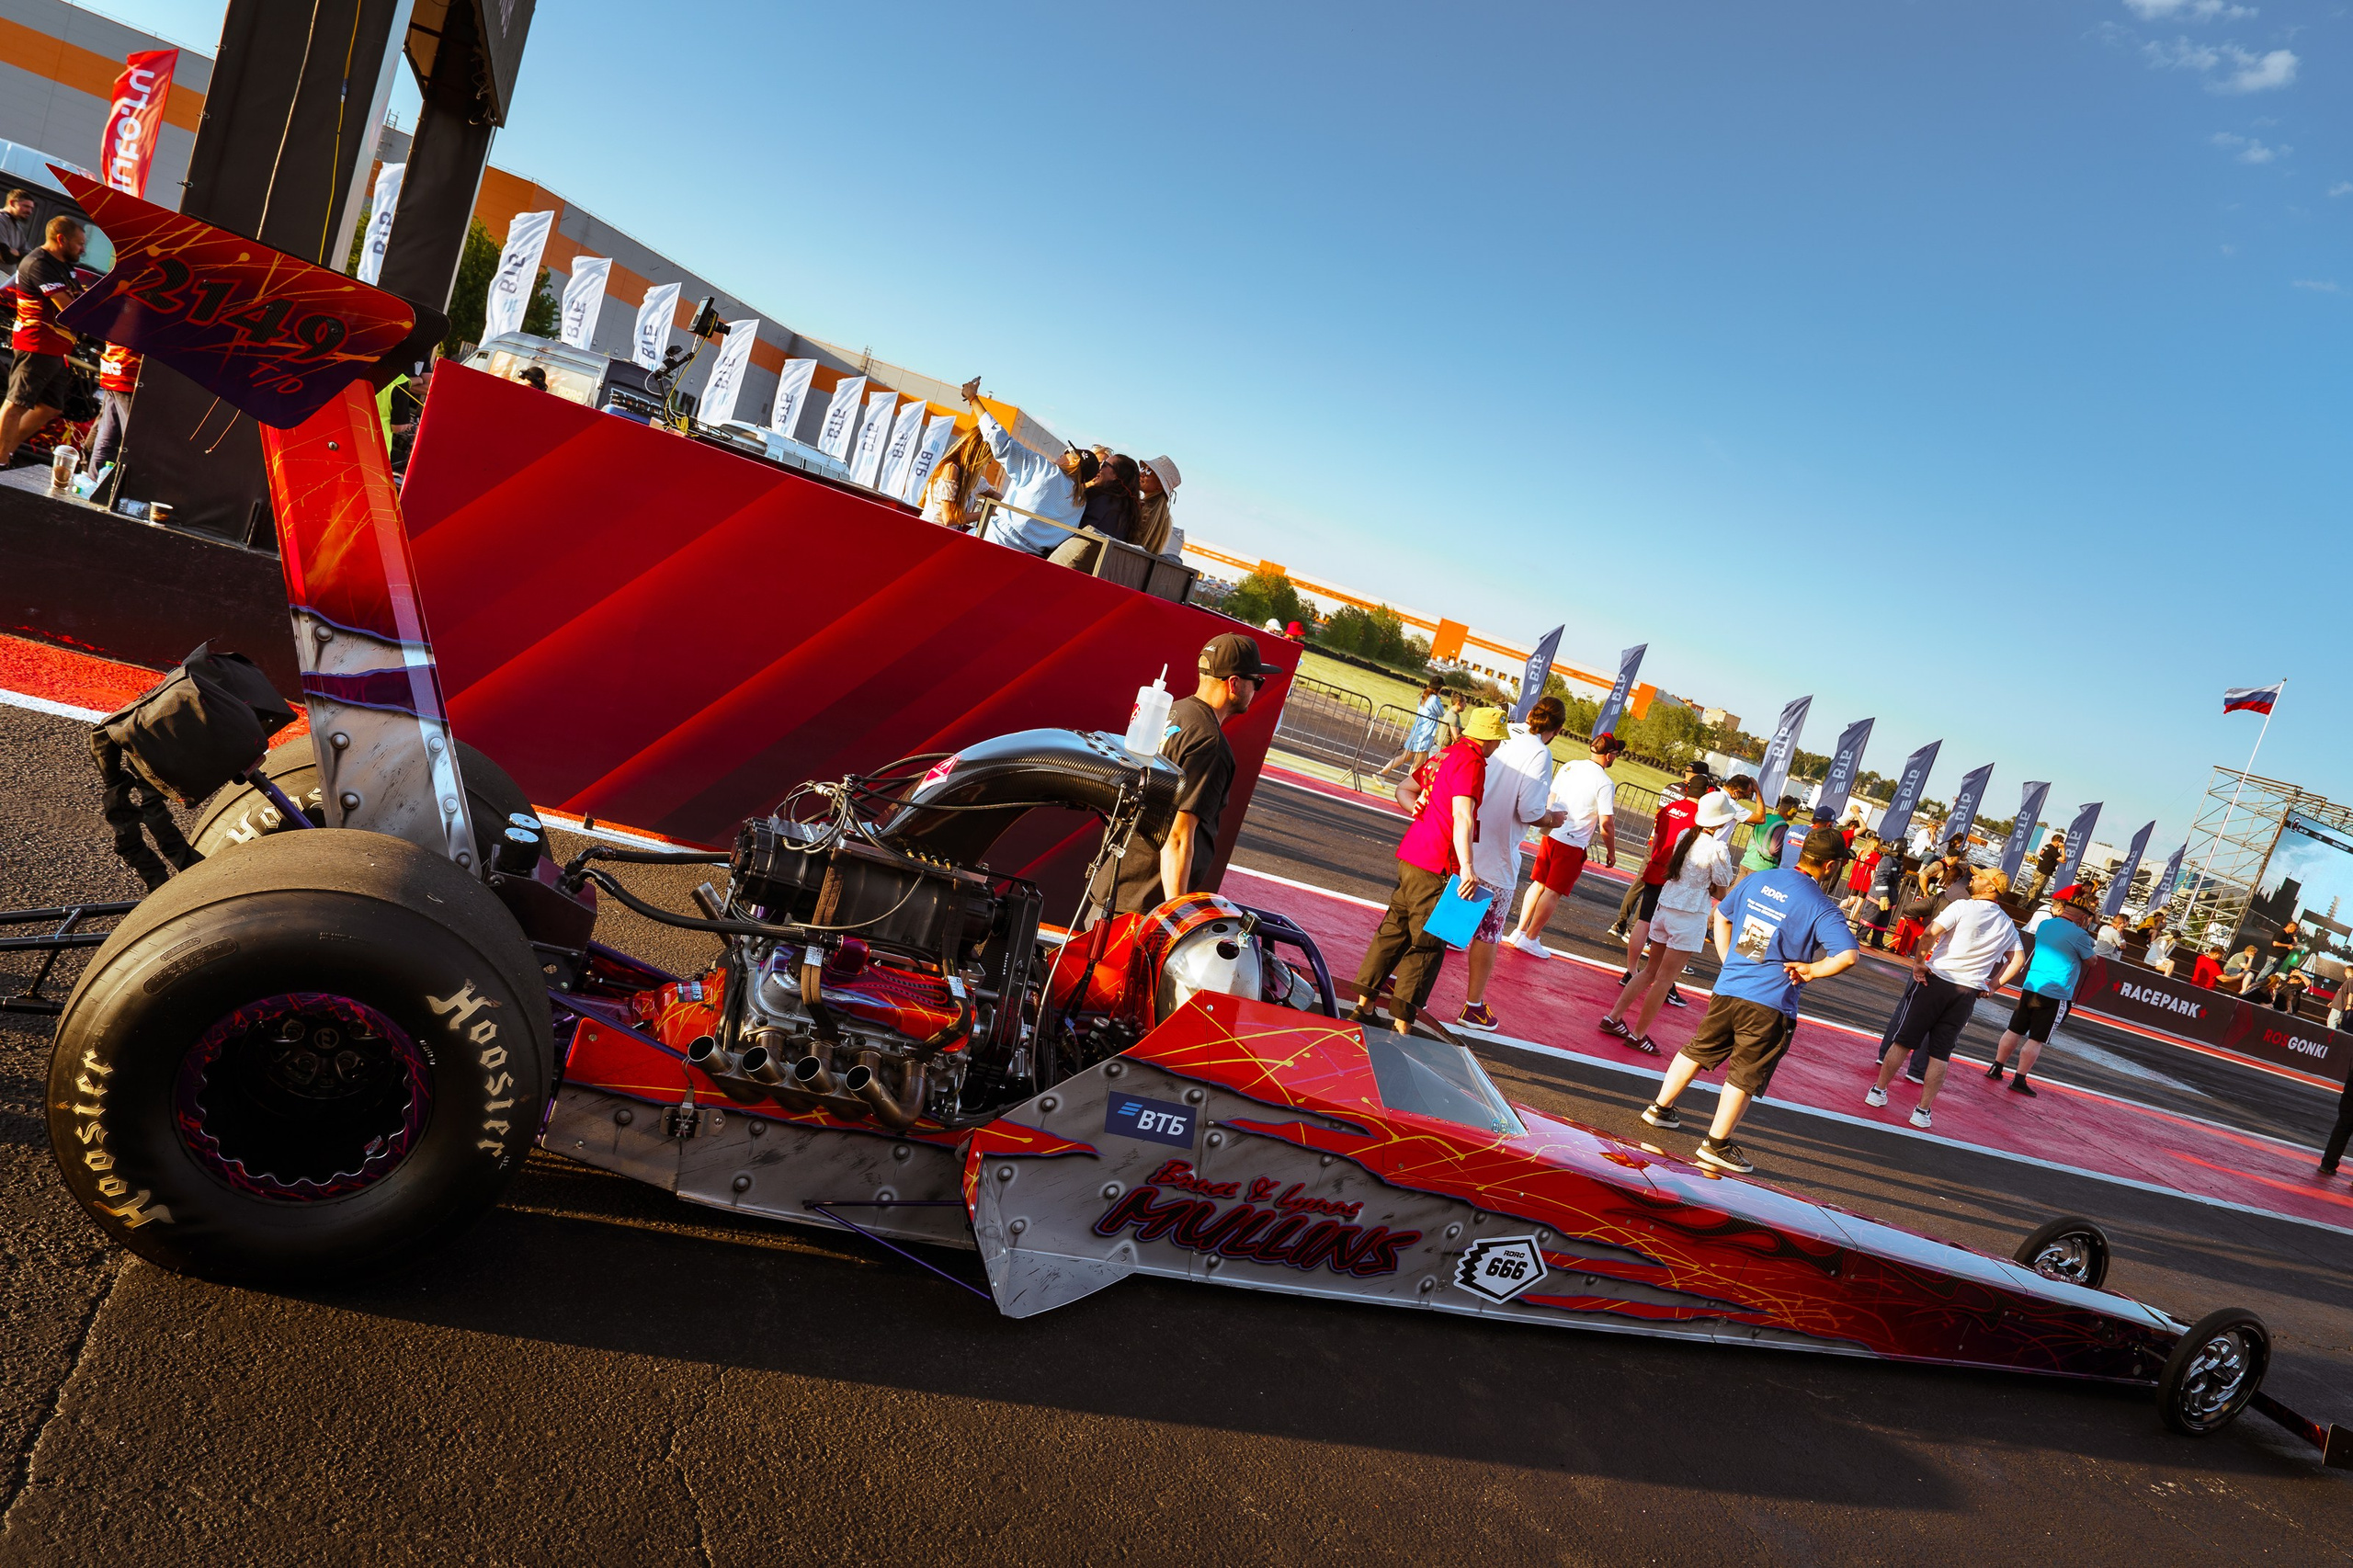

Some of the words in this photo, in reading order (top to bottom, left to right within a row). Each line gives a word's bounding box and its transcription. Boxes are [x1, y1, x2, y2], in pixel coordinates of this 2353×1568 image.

[126, 255, 348, 363] 2149
[915, 449, 934, 478] ВТБ
[1760, 885, 1789, 903] RDRC
[2120, 982, 2200, 1018] RACEPARK
[2263, 1028, 2328, 1059] ROSGONKI
[426, 978, 515, 1157] Hoosier
[1137, 1109, 1188, 1136] ВТБ
[72, 1049, 176, 1230] Hoosier
[1149, 1159, 1241, 1197] Bruce
[1246, 1177, 1280, 1202] &
[1274, 1183, 1364, 1219] Lynne
[1094, 1186, 1423, 1278] MULLINS
[1485, 1257, 1528, 1280] 666
[1503, 1250, 1525, 1258] RDRC
